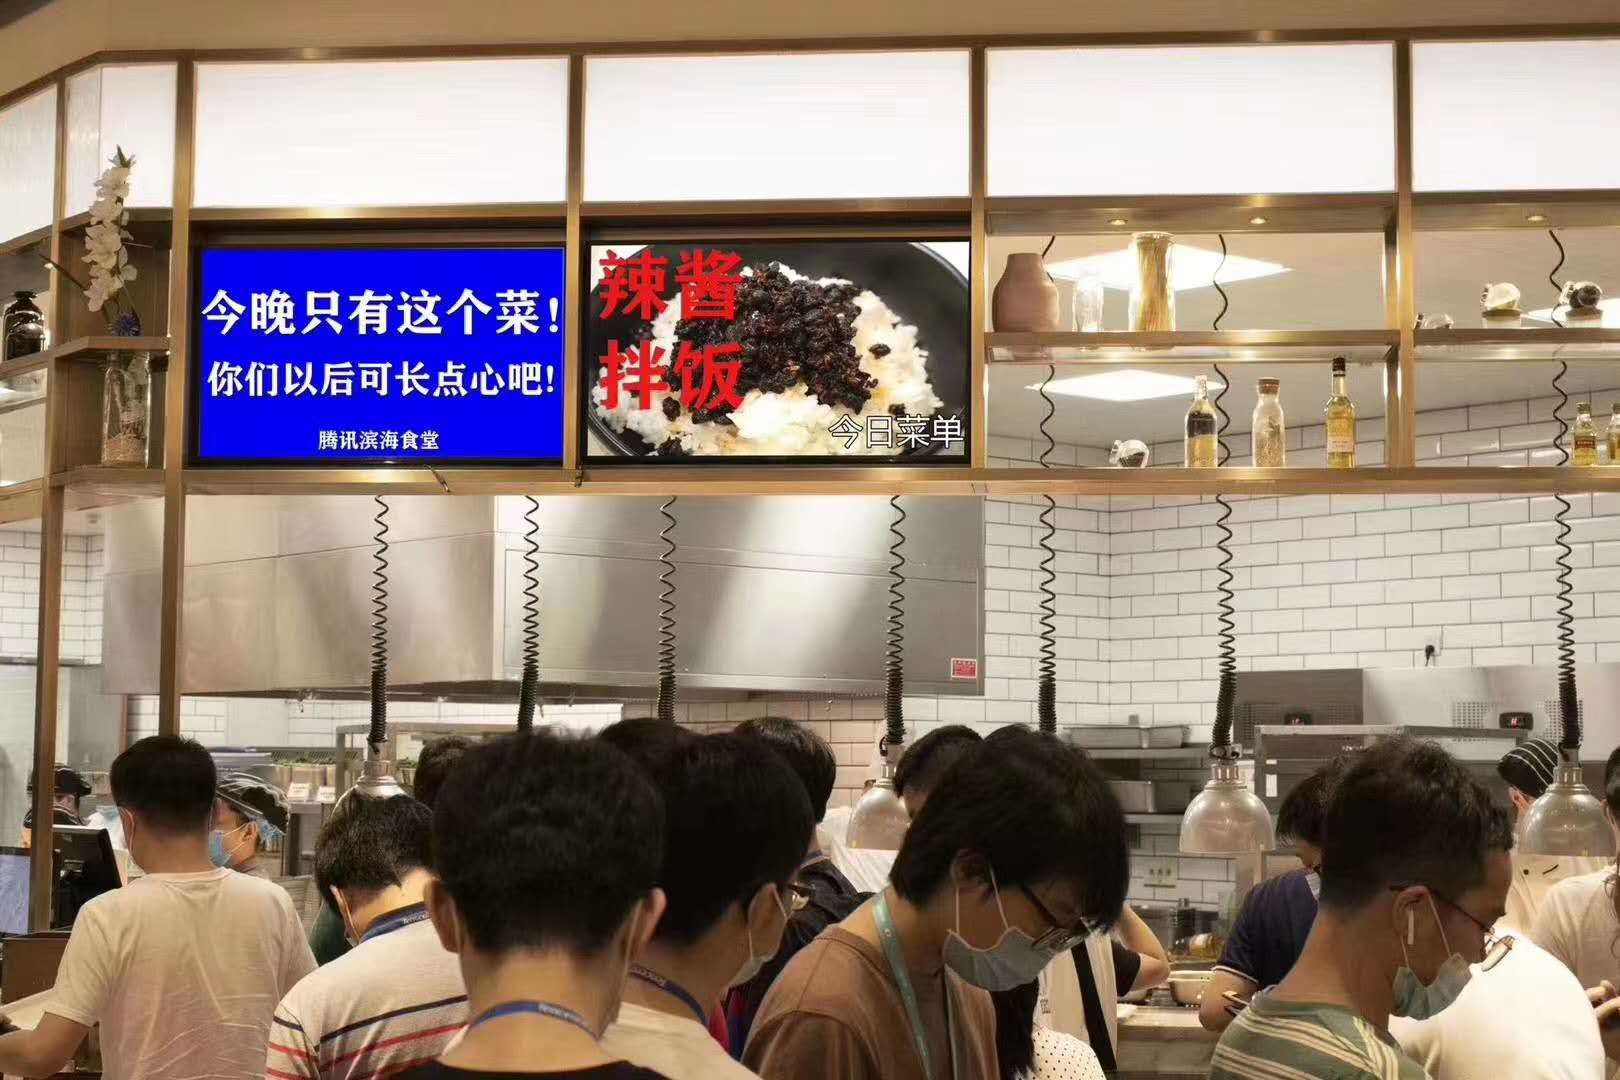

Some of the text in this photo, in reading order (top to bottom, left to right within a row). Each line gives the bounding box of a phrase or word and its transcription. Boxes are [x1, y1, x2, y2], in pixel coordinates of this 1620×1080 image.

[599, 249, 743, 321] 辣酱
[201, 288, 560, 335] 今晚只有这个菜!
[207, 361, 555, 397] 你们以后可长点心吧!
[599, 339, 744, 411] 拌饭
[318, 430, 440, 450] 腾讯滨海食堂
[829, 414, 965, 449] 今日菜单
